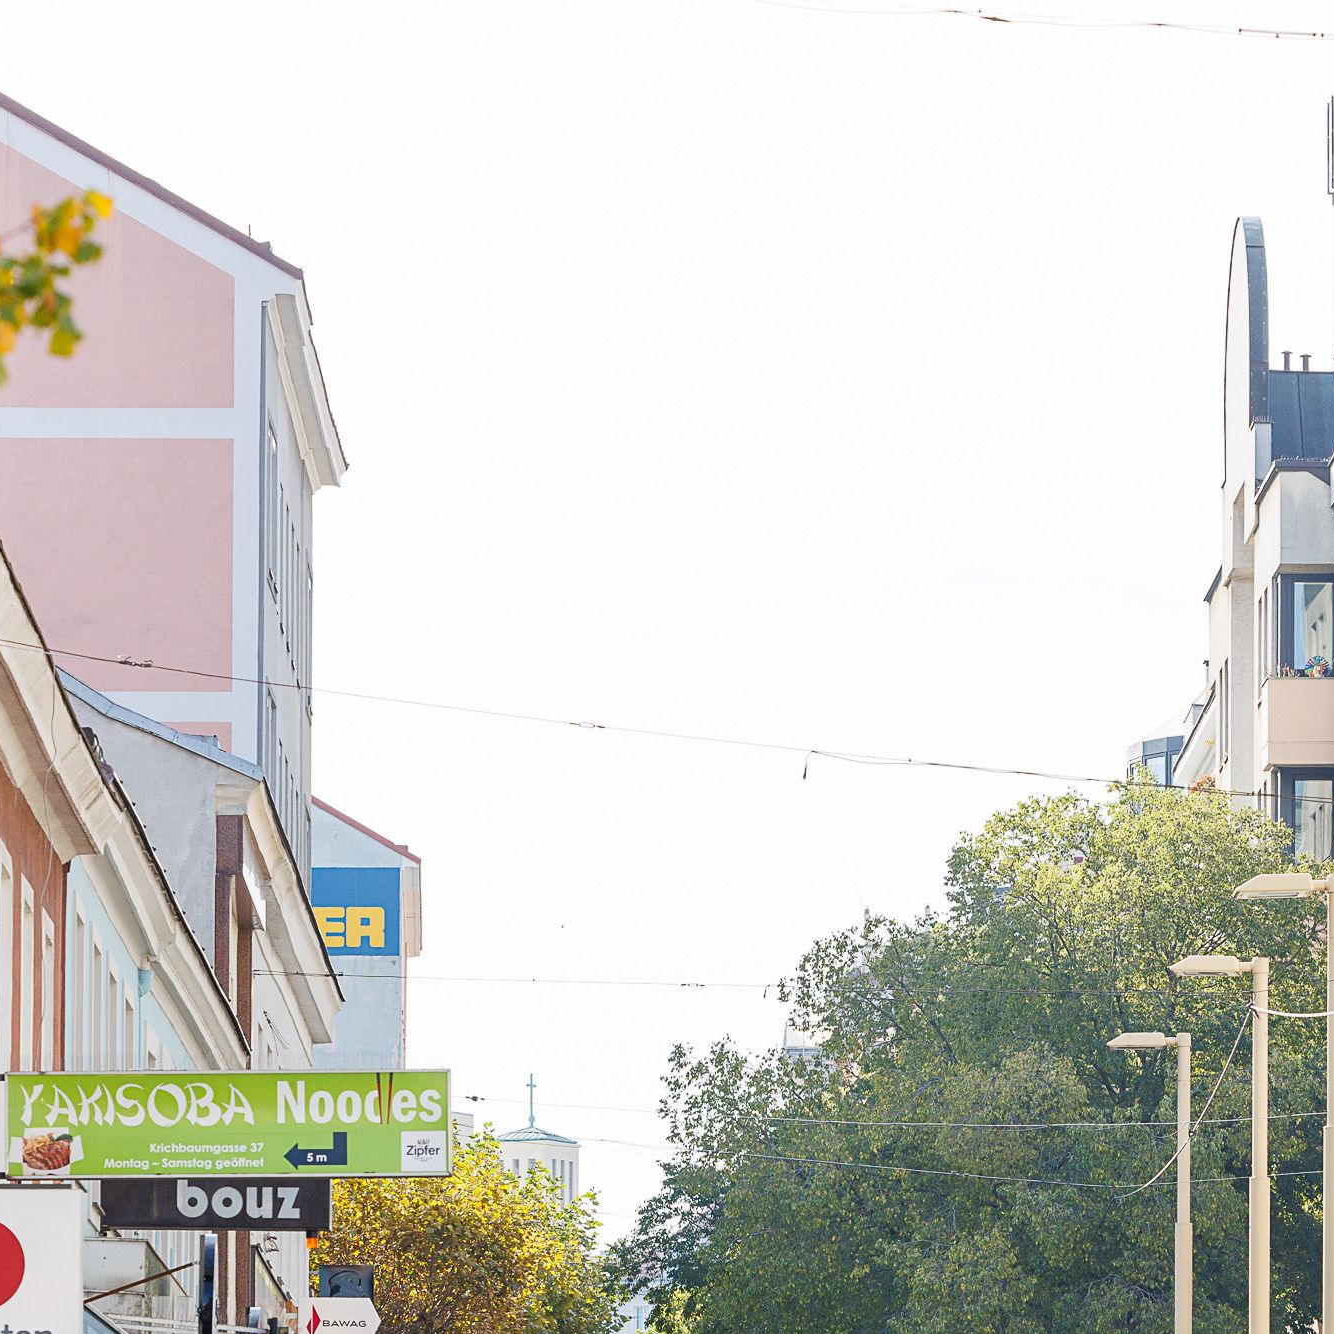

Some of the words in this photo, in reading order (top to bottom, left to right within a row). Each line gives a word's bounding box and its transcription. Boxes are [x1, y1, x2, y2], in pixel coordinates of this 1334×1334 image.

[19, 1082, 255, 1127] YAKISOBA
[149, 1142, 245, 1155] Krichbaumgasse
[250, 1142, 264, 1152] 37
[406, 1145, 440, 1157] Zipfer
[104, 1158, 149, 1170] Montag
[162, 1158, 212, 1170] Samstag
[215, 1157, 264, 1170] geöffnet
[306, 1153, 313, 1163] 5
[317, 1155, 327, 1163] m
[176, 1180, 300, 1219] bouz
